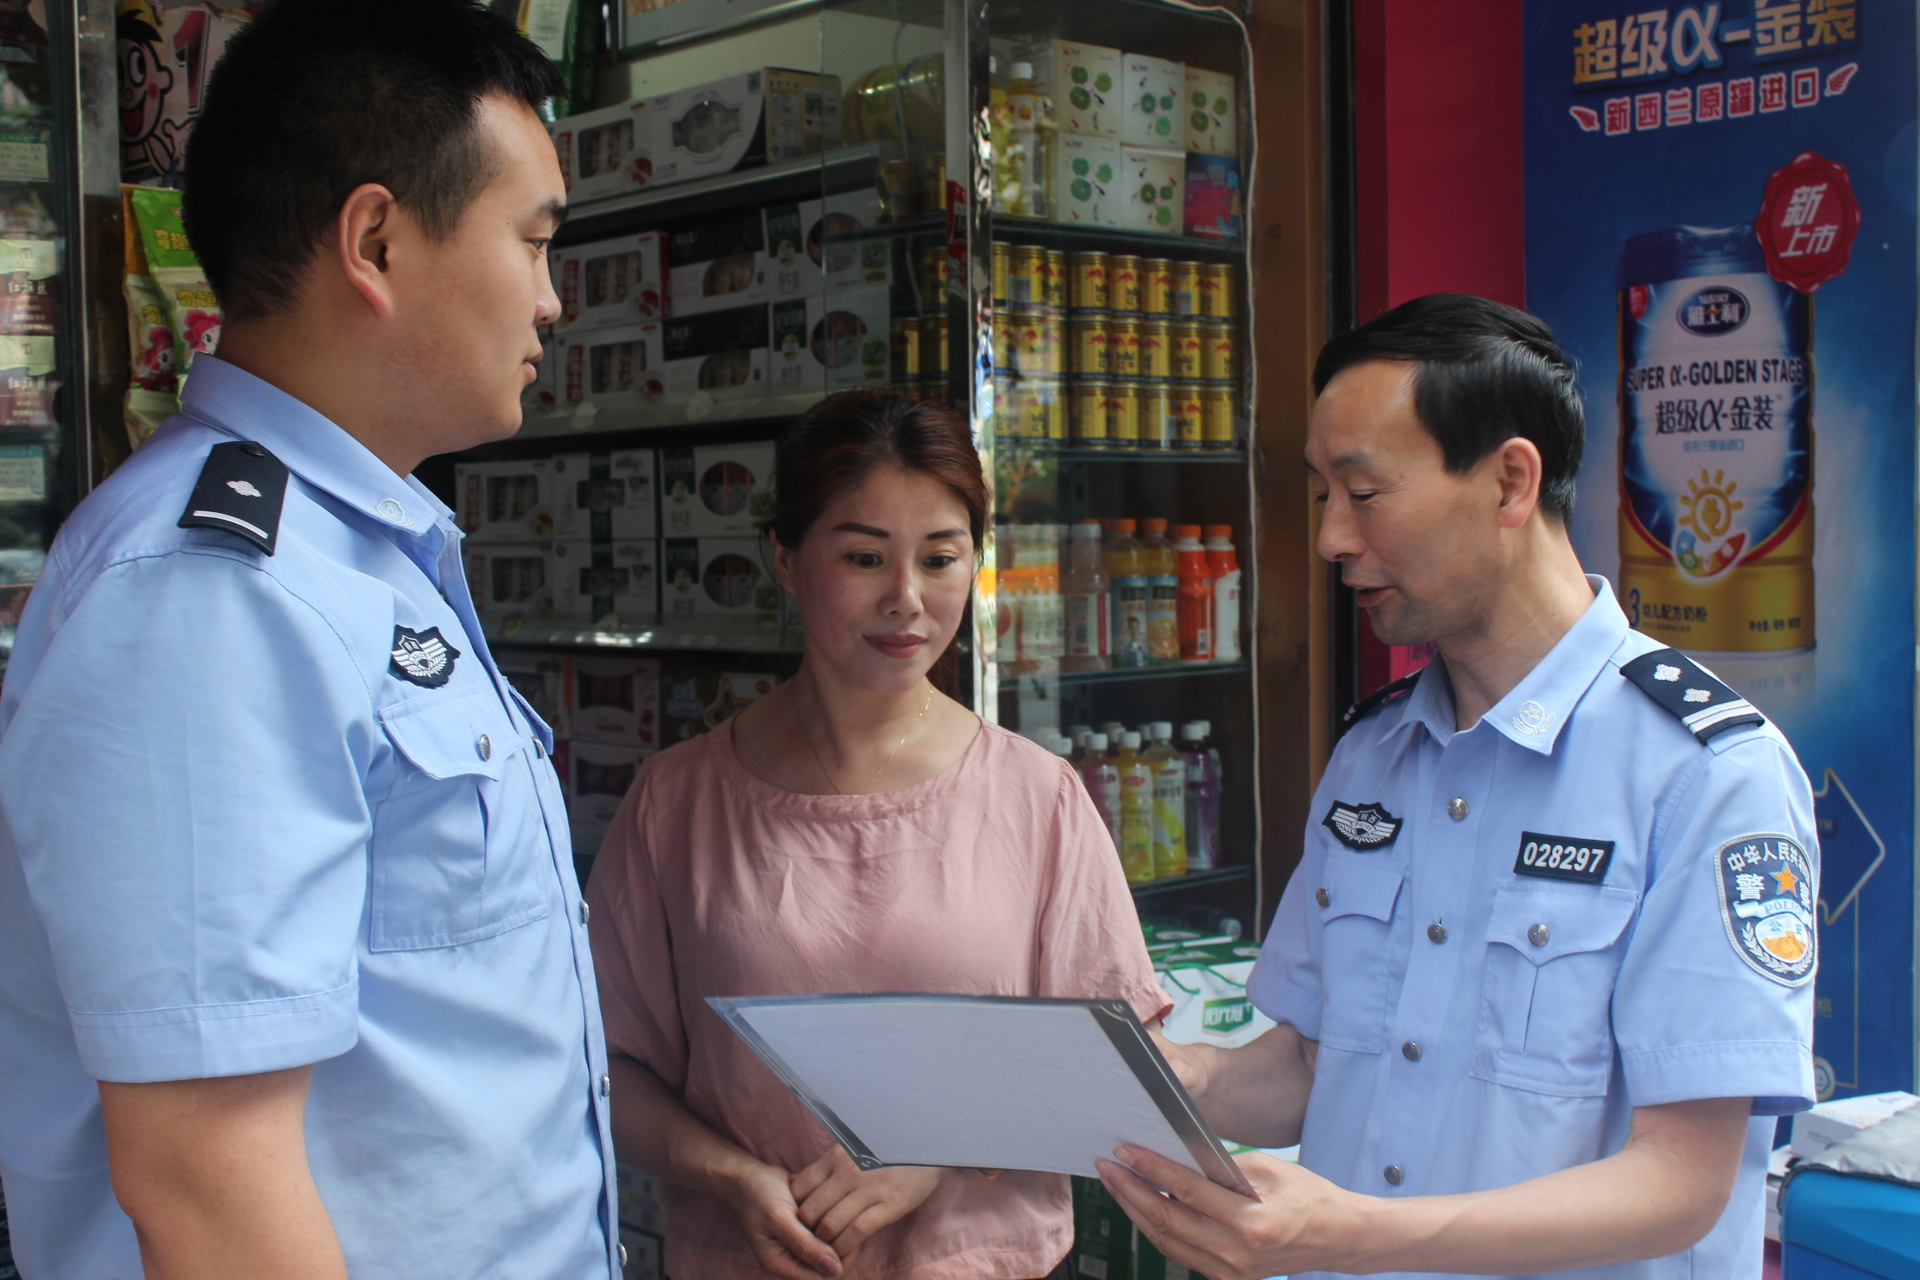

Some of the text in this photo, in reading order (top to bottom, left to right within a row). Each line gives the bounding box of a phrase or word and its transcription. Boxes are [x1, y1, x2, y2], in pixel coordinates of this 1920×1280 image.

[1605, 67, 1819, 136] 新西兰原罐进口
[1781, 183, 1828, 228] 新
[1779, 224, 1839, 258] 上市
[1627, 365, 1665, 392] SUPER
[1761, 357, 1803, 385] STAGE
[1628, 587, 1641, 629] 3
[1523, 841, 1605, 874] 028297
[1735, 873, 1766, 901] 警
